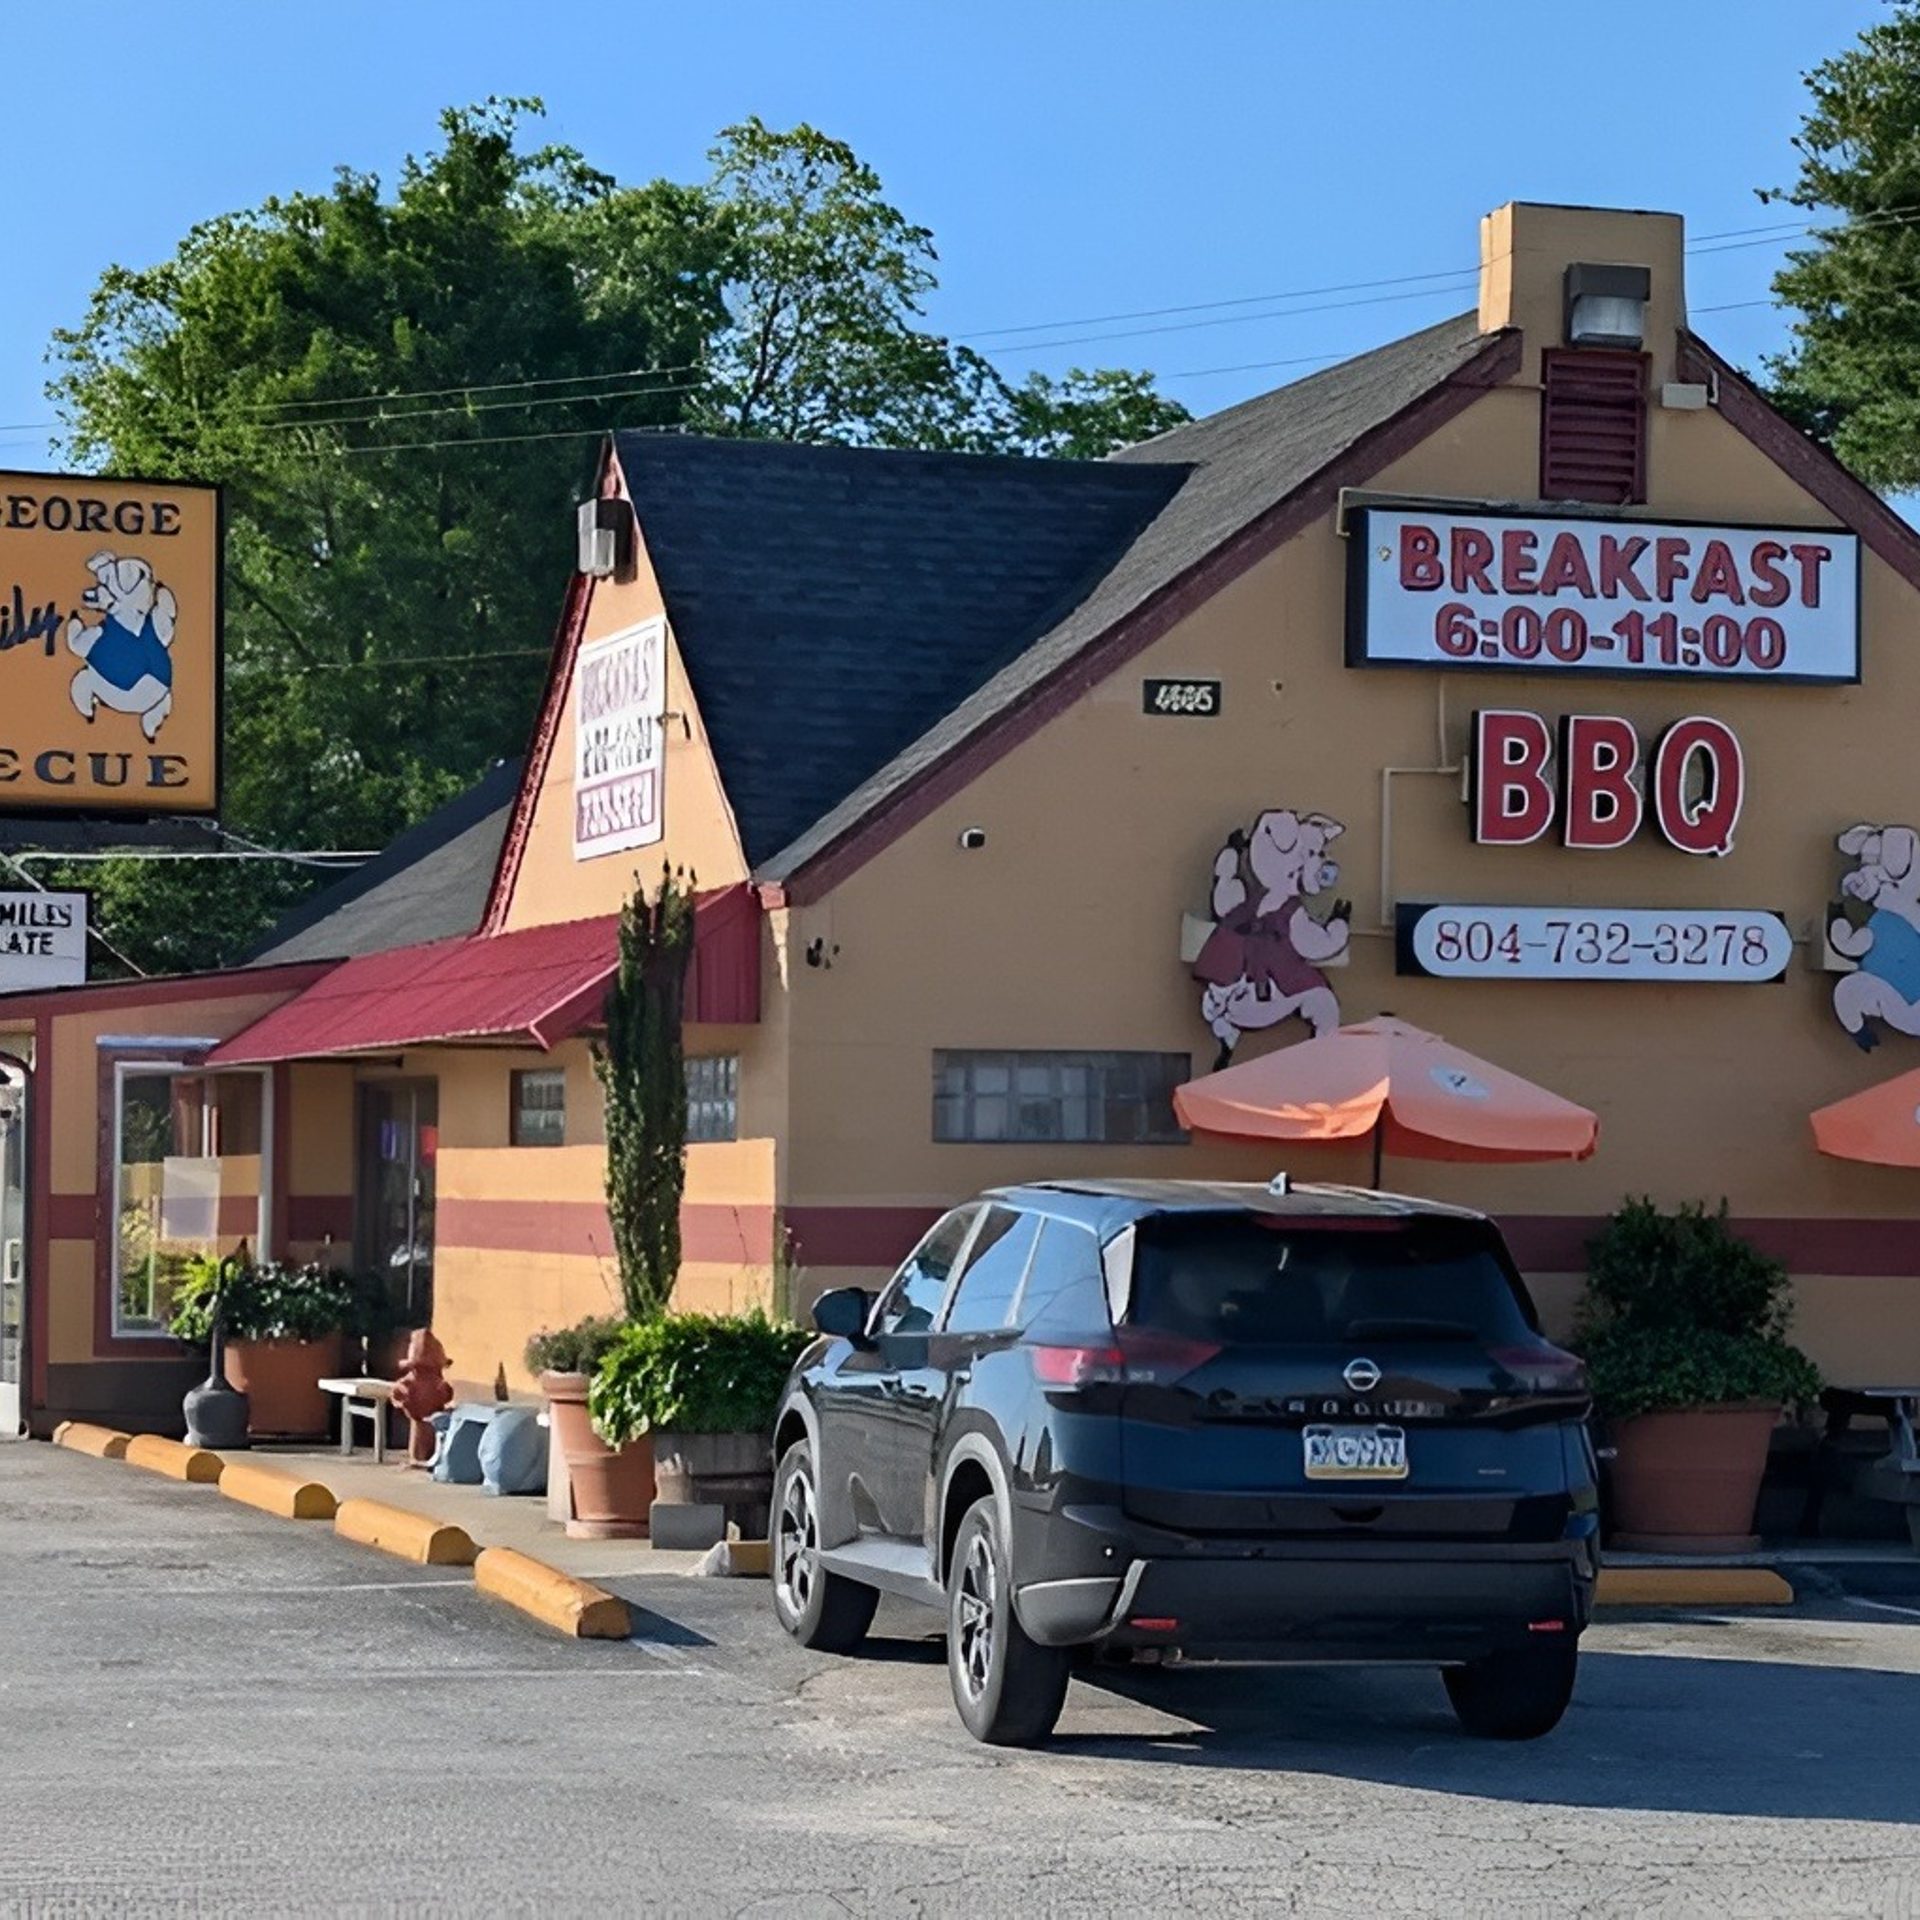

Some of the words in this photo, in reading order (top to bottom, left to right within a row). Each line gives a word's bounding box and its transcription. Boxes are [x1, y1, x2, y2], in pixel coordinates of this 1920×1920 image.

[0, 494, 182, 536] EORGE
[1400, 525, 1831, 608] BREAKFAST
[1435, 602, 1787, 670] 6:00-11:00
[1474, 709, 1745, 857] BBQ
[1435, 921, 1770, 967] 804-732-3278
